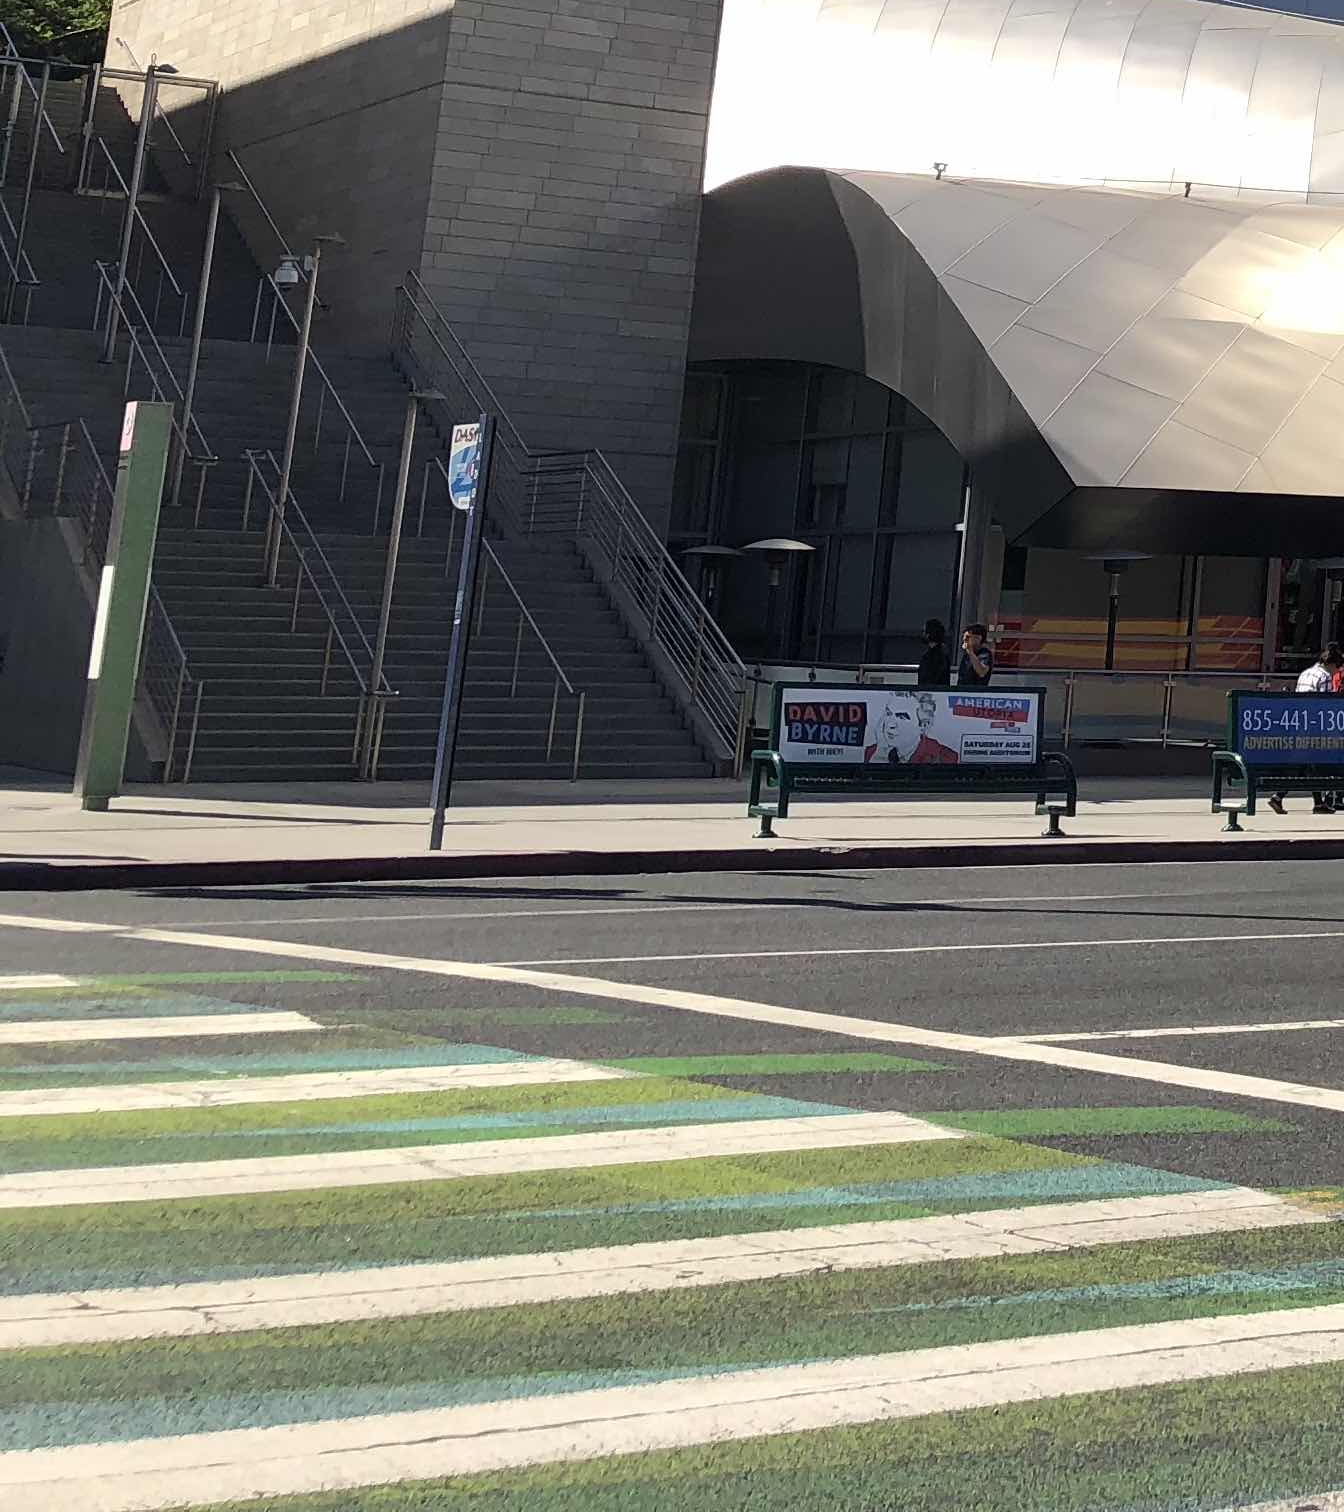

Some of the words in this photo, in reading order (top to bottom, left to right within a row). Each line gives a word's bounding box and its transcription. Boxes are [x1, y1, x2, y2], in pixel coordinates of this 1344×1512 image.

[956, 697, 1022, 710] AMERICAN
[788, 704, 862, 722] DAVID
[791, 722, 859, 744] BYRNE
[1243, 735, 1294, 750] ADVERTISE
